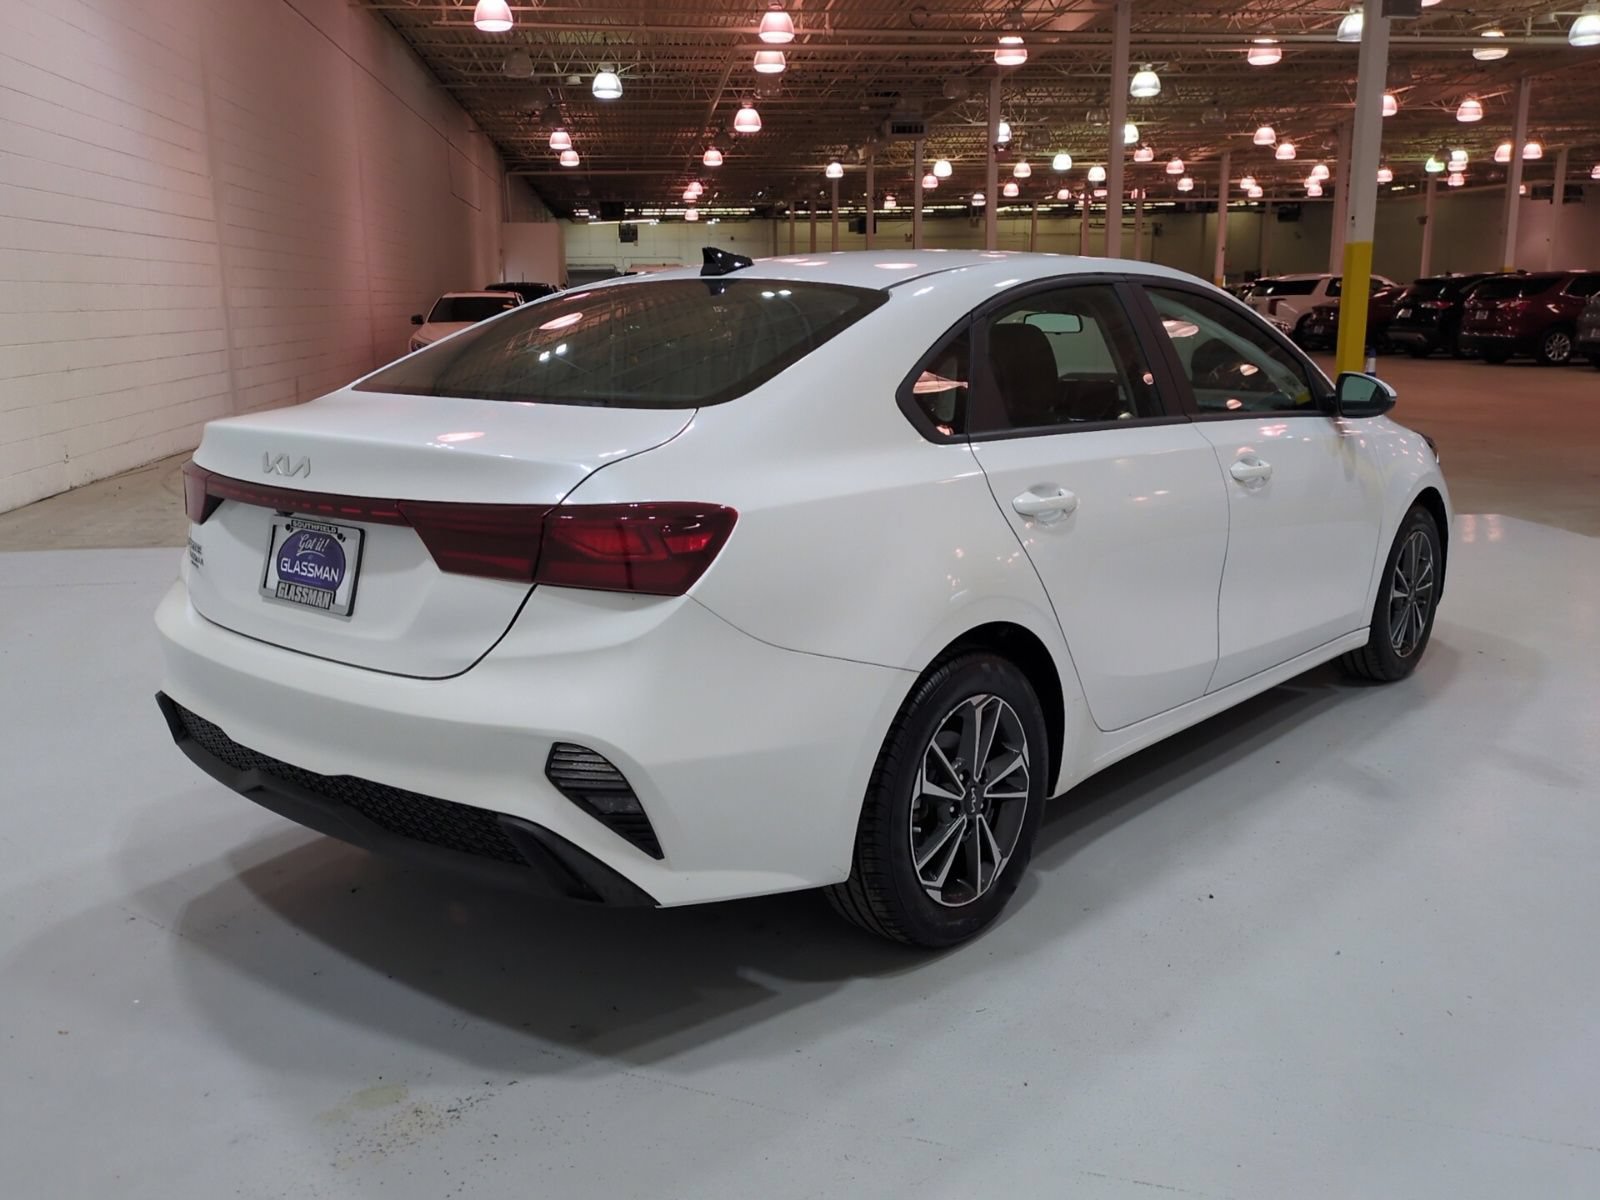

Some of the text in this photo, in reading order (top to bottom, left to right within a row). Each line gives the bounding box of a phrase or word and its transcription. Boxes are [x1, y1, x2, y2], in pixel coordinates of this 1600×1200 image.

[262, 451, 311, 478] KIA
[292, 520, 337, 534] SOUTHFIELD
[297, 533, 330, 552] Got it!
[280, 557, 339, 582] GLASSMAN
[277, 583, 331, 609] GLASSMAN
